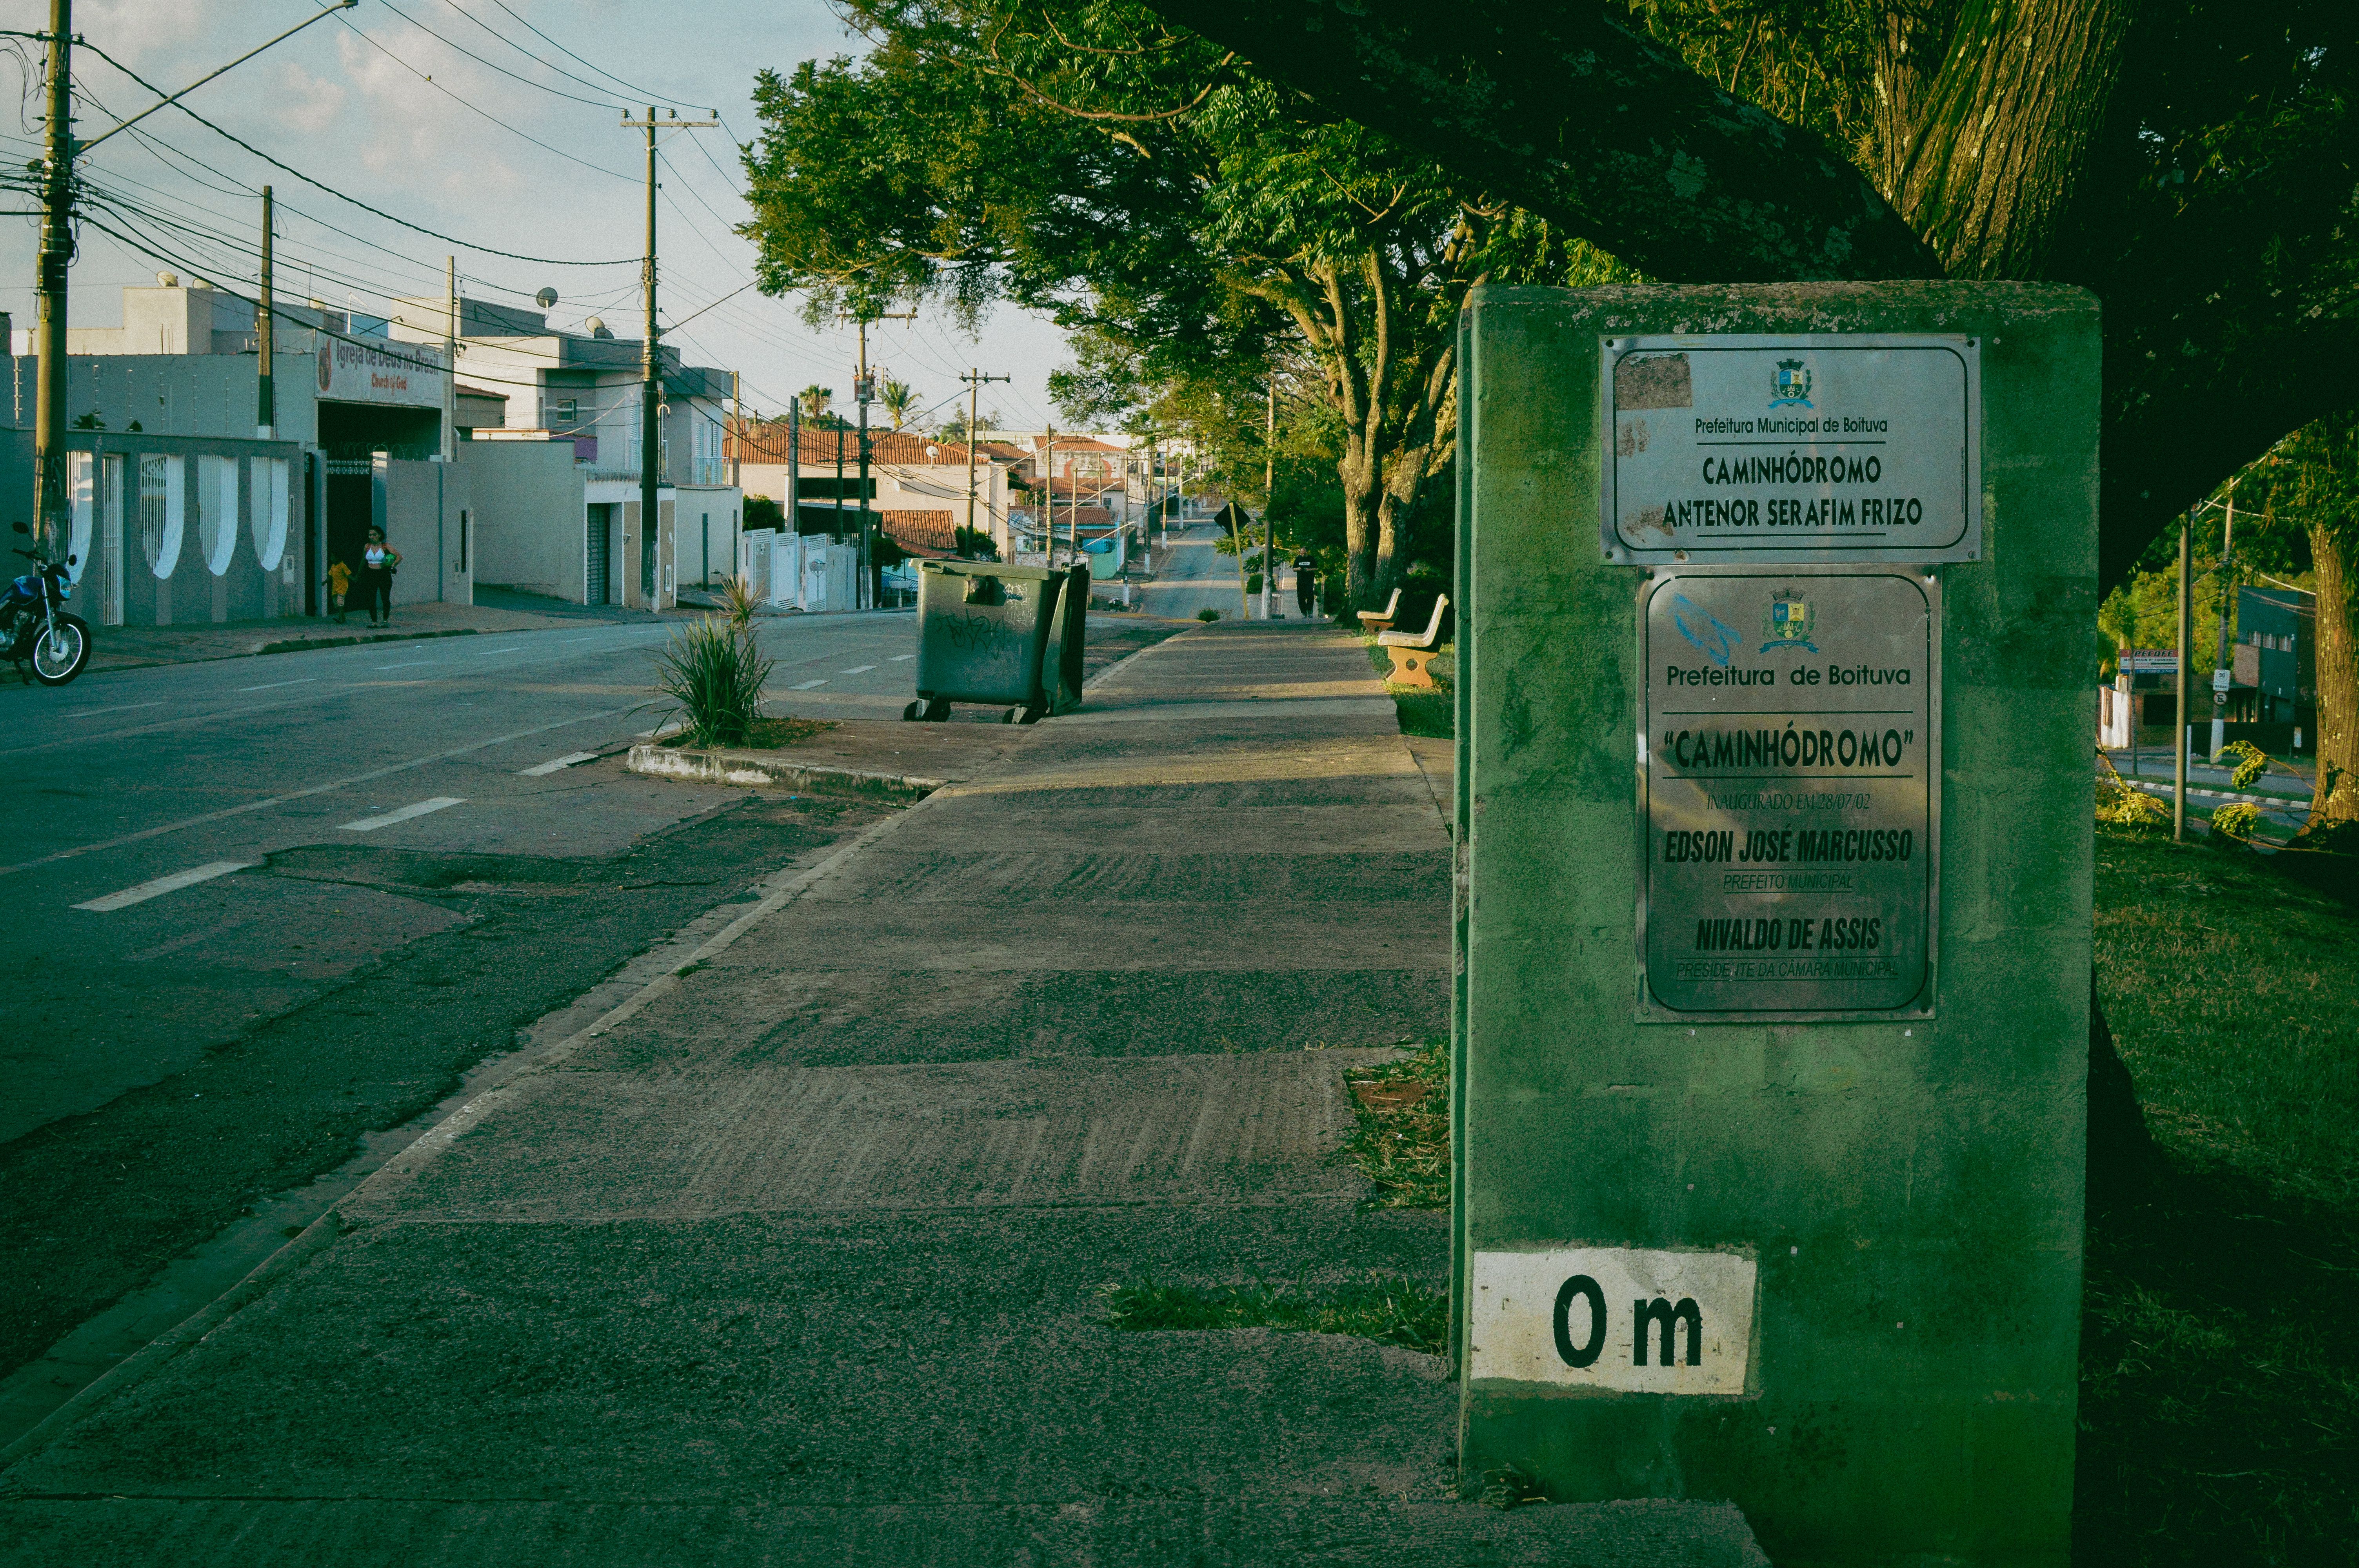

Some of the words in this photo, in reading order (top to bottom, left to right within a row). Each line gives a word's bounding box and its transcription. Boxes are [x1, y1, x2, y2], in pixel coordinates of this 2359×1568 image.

[337, 339, 363, 370] Igreja
[366, 343, 376, 366] de
[379, 343, 402, 369] Deus
[416, 350, 438, 376] Brasil
[1696, 418, 1753, 434] Prefeitura
[1757, 418, 1818, 436] Municipal
[1823, 417, 1839, 433] de
[1843, 417, 1887, 433] Boituva
[1703, 450, 1881, 485] CAMINHÓDROMO
[1663, 499, 1758, 528] ANTENOR
[1768, 499, 1853, 526] SERAFIM
[1862, 497, 1922, 525] FRIZO
[1667, 665, 1775, 686] Prefeitura
[1790, 665, 1821, 686] de
[1829, 664, 1910, 685] Boituva
[1707, 794, 1793, 810] INAUGURADO
[1796, 793, 1814, 809] EM
[1819, 793, 1870, 811] 28/07/02
[1665, 830, 1734, 863] EDSON
[1739, 824, 1791, 862] JOSÉ
[1797, 829, 1913, 862] MARCUSSO
[1724, 874, 1785, 889] PREFEITO
[1788, 873, 1853, 889] MUNICIPAL
[1697, 918, 1781, 951] NIVALDO
[1788, 918, 1814, 950] DE
[1819, 917, 1881, 949] ASSIS
[1677, 962, 1755, 978] PRESIDENTE
[1758, 962, 1774, 976] DA
[1778, 959, 1830, 976] CÂMARA
[1834, 962, 1899, 976] MUNICIPAL
[1553, 1274, 1607, 1368] 0
[1633, 1297, 1701, 1366] m
